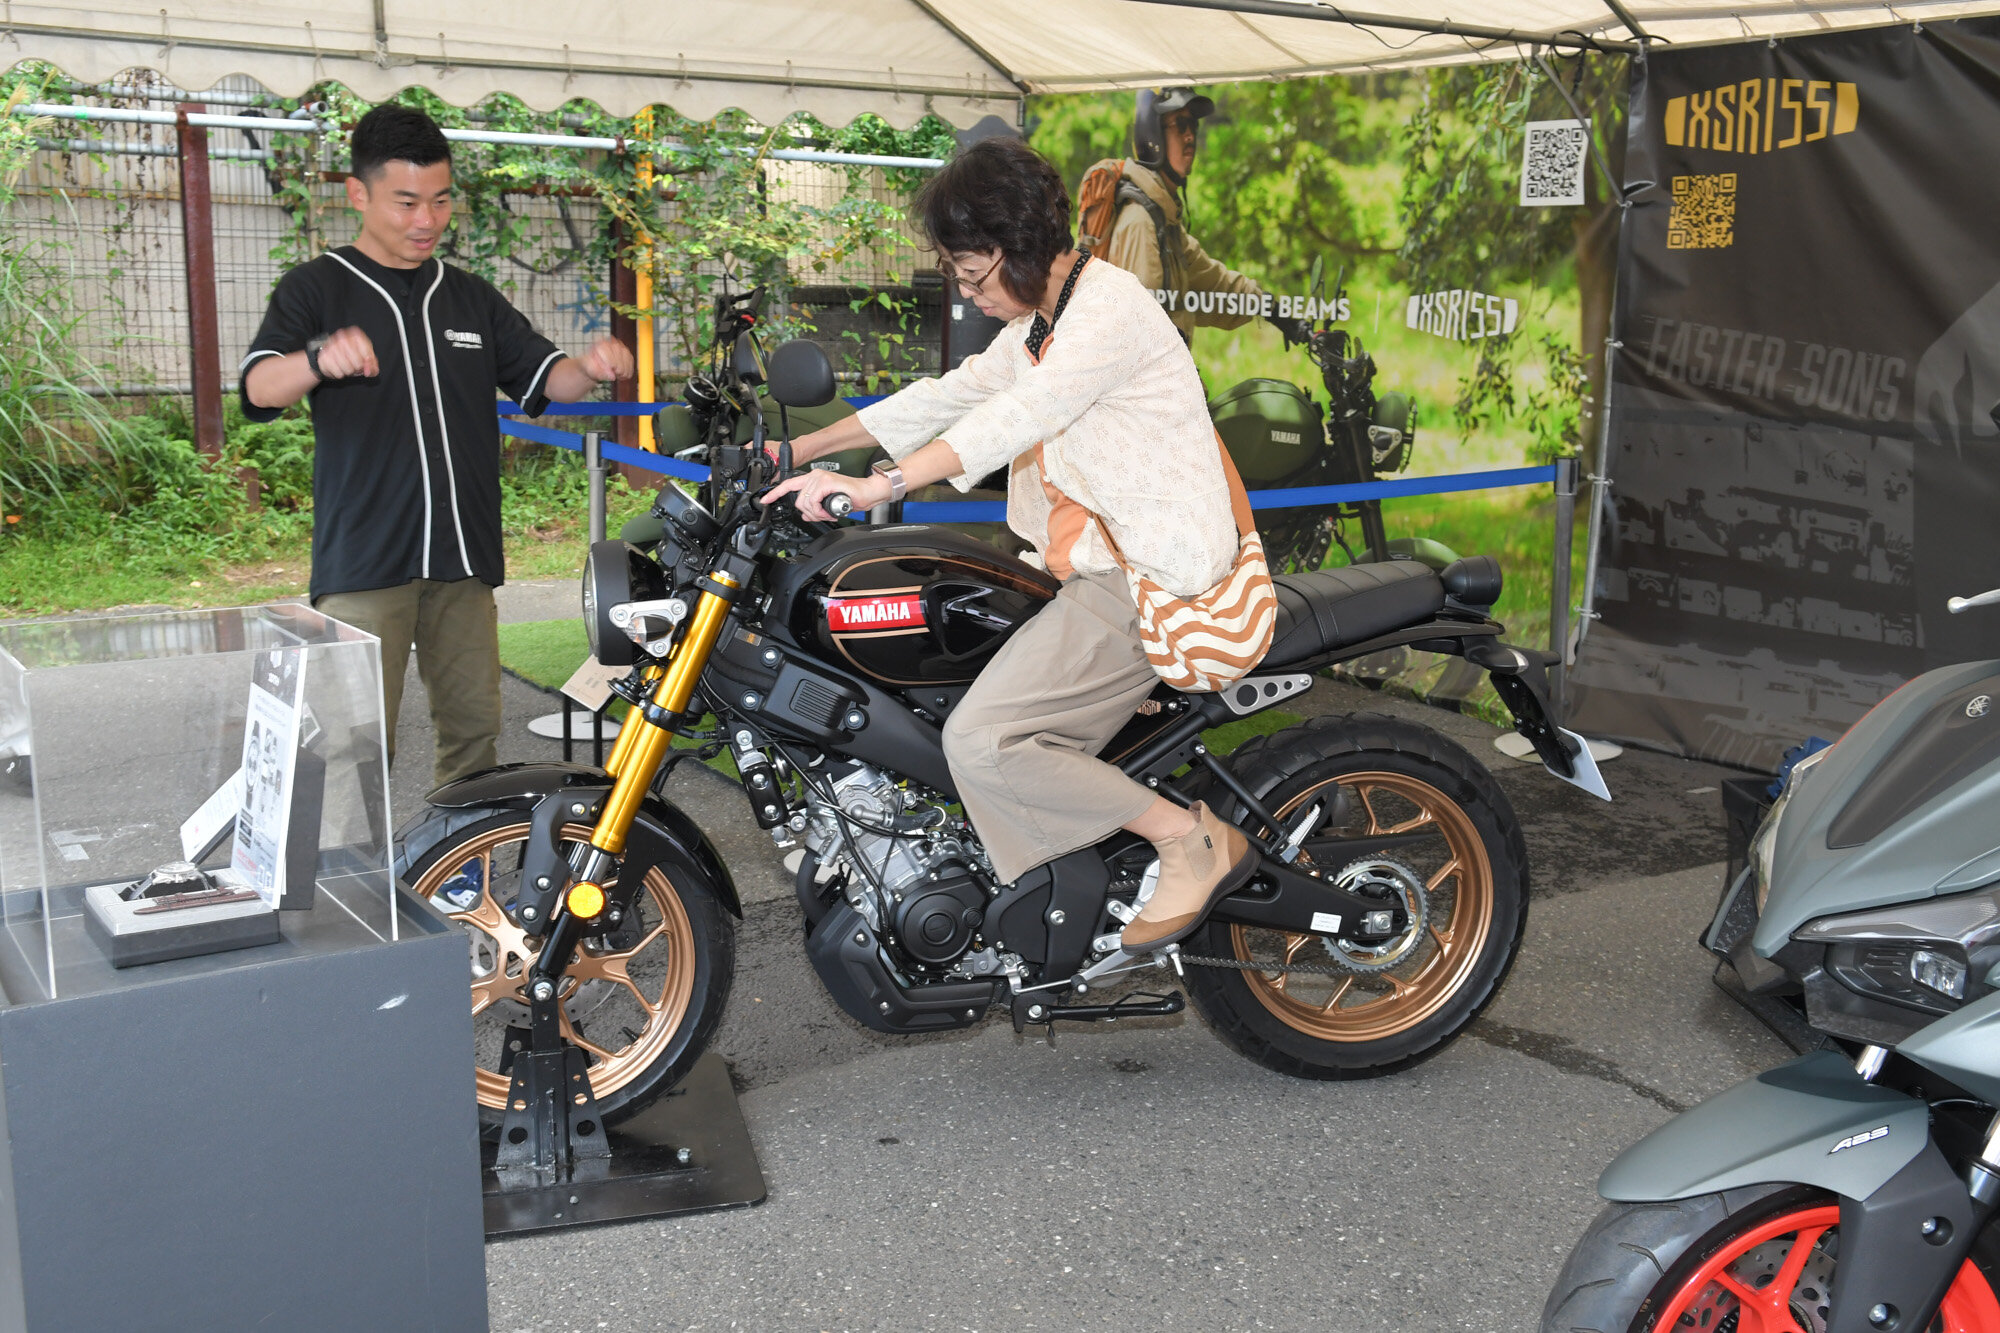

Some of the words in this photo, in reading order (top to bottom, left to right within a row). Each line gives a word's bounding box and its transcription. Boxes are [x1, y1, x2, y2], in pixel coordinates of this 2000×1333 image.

[1688, 78, 1831, 154] XSR155
[1146, 288, 1179, 311] PY
[1184, 291, 1272, 317] OUTSIDE
[1278, 295, 1350, 321] BEAMS
[1419, 289, 1502, 341] XSR155
[1646, 317, 1786, 400] FASTER
[1794, 343, 1906, 422] SONS
[840, 602, 911, 624] YAMAHA
[1829, 1125, 1889, 1154] ABS
